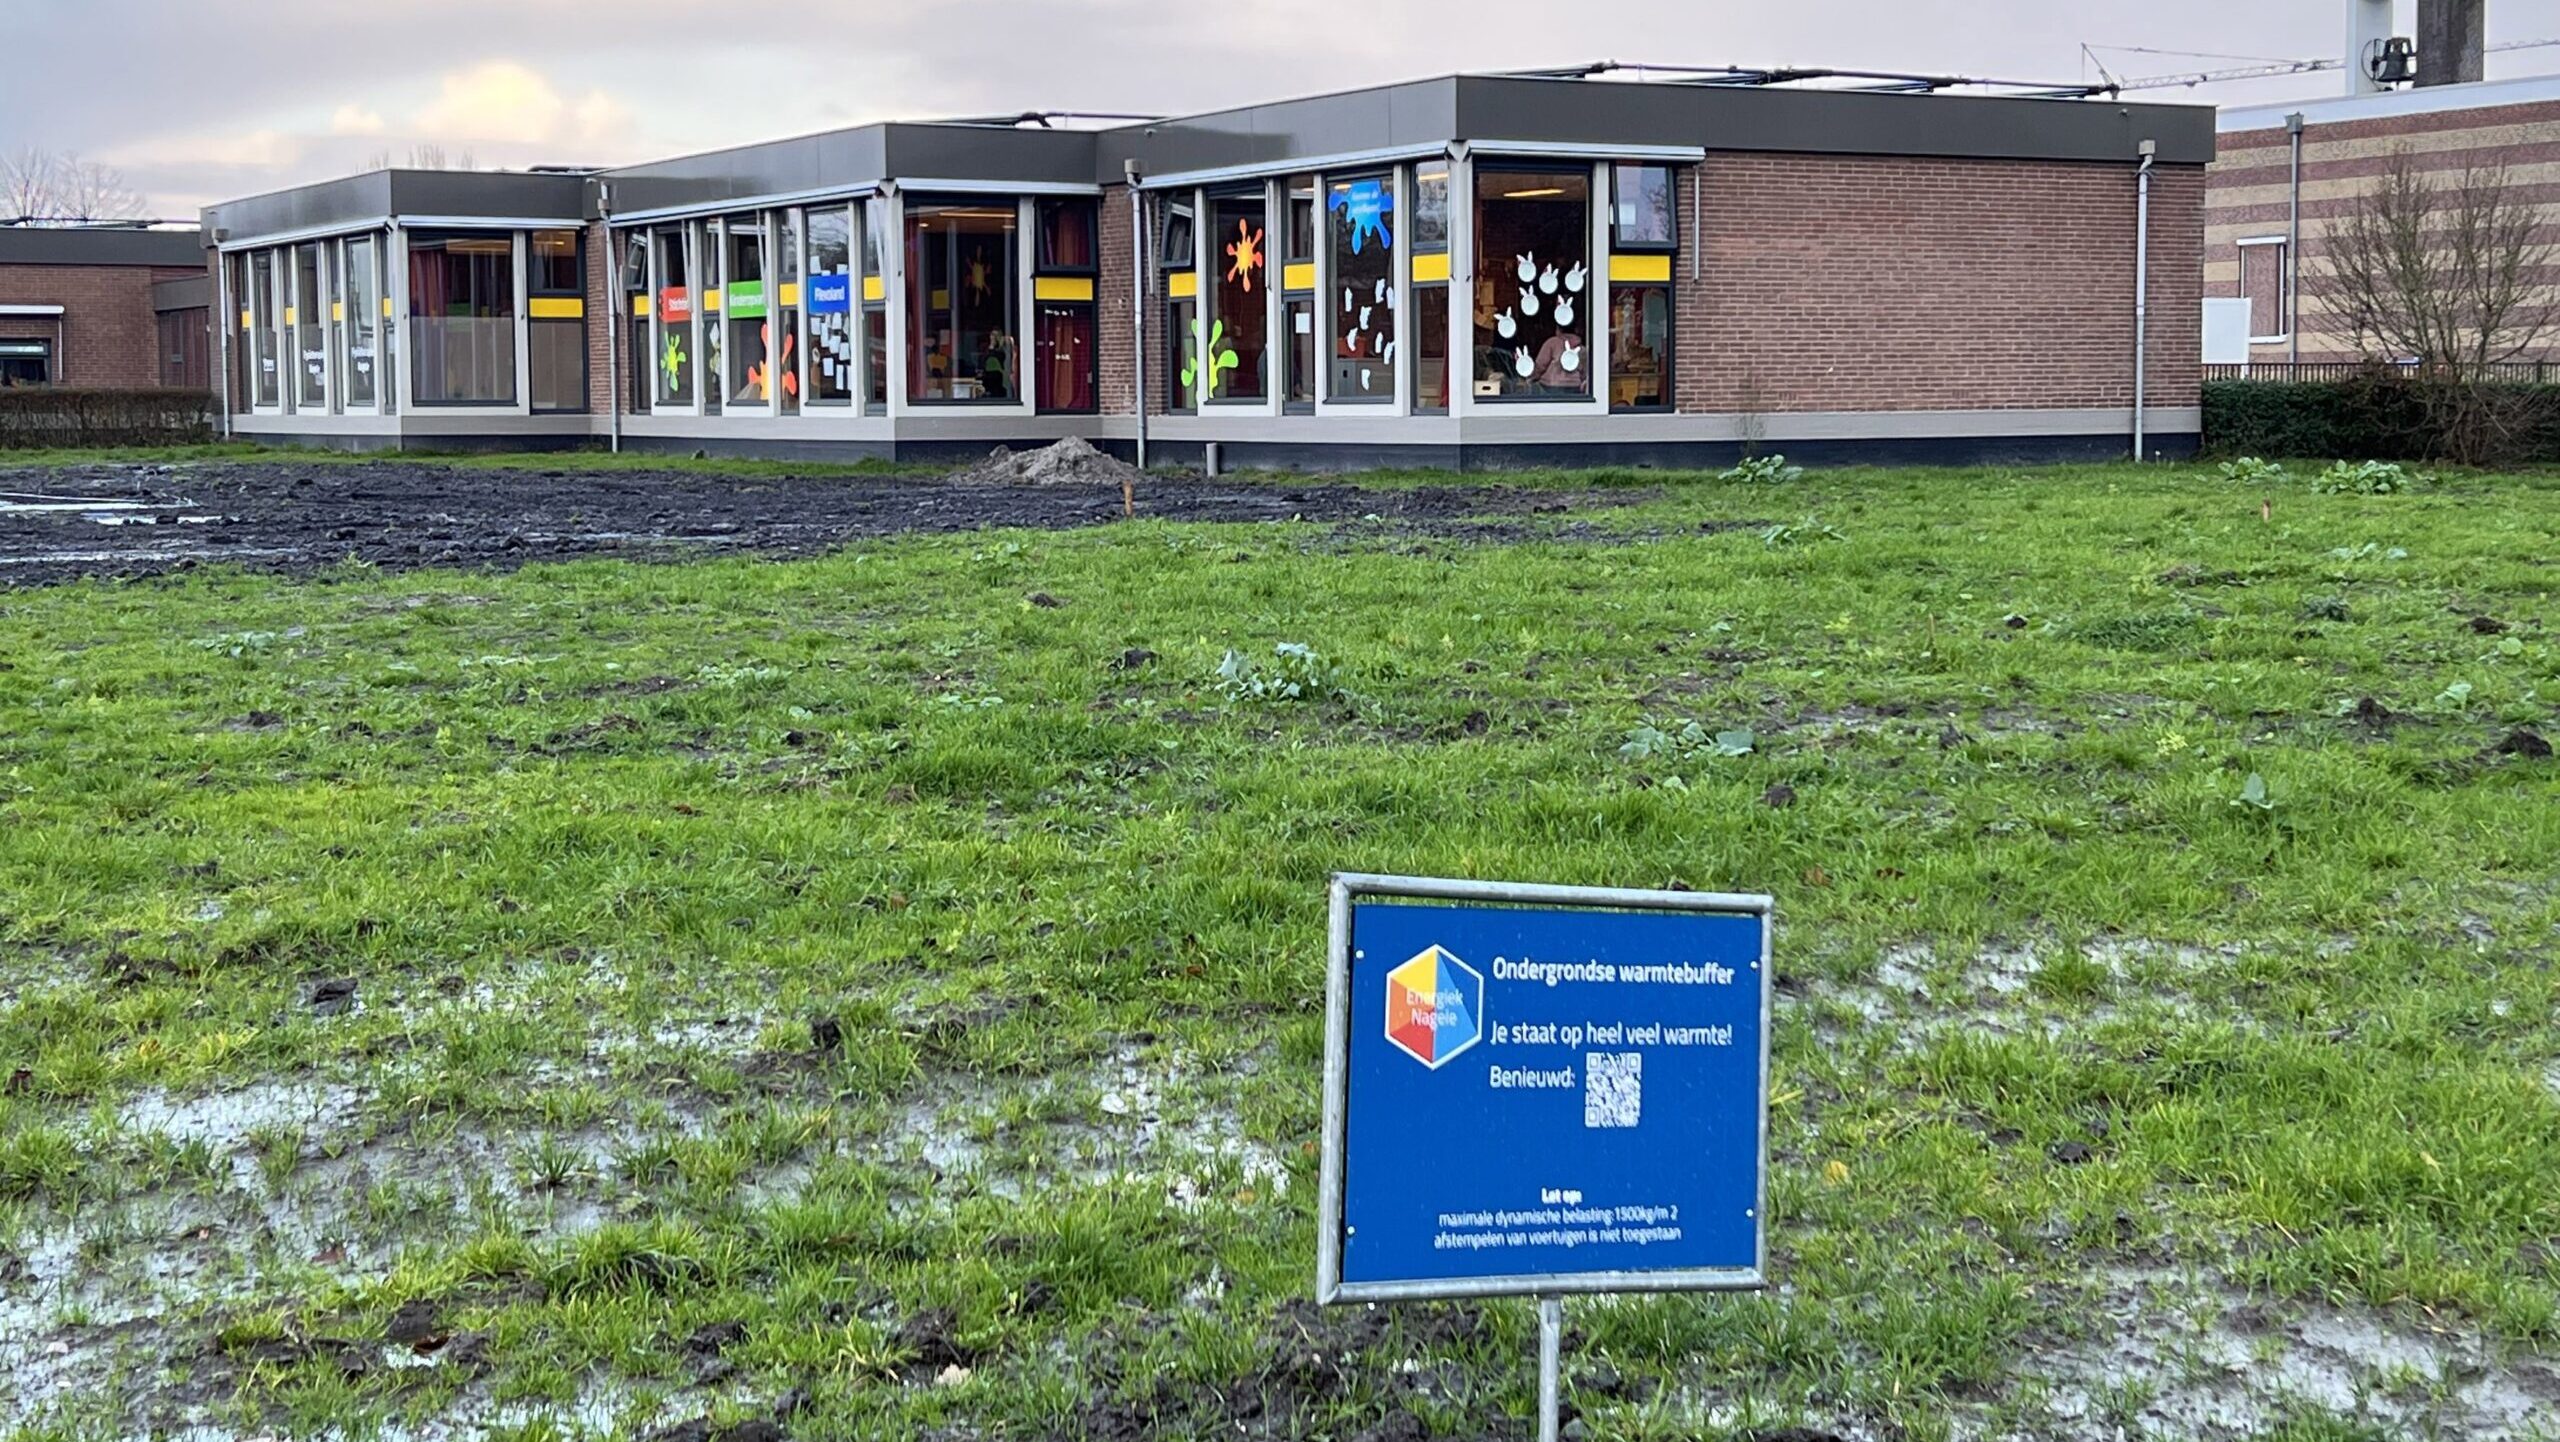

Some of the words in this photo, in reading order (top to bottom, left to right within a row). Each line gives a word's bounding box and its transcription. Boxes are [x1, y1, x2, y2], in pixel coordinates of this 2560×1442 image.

[1493, 956, 1616, 987] Ondergrondse
[1619, 961, 1735, 985] warmtebuffer
[1406, 988, 1463, 1010] Energiek
[1411, 1007, 1458, 1032] Nagele
[1490, 1020, 1508, 1046] Je
[1512, 1021, 1557, 1045] staat
[1560, 1026, 1583, 1050] op
[1586, 1020, 1623, 1045] heel
[1625, 1022, 1661, 1046] veel
[1663, 1023, 1733, 1046] warmte!
[1490, 1065, 1576, 1089] Benieuwd:
[1541, 1188, 1561, 1205] Let
[1439, 1209, 1494, 1228] maximale
[1495, 1208, 1561, 1229] dynamische
[1434, 1230, 1505, 1252] afstempelen
[1506, 1232, 1527, 1246] van
[1528, 1228, 1587, 1248] voertuigen
[1588, 1227, 1598, 1243] is
[1600, 1227, 1621, 1242] niet
[1622, 1226, 1681, 1245] toegestaan
